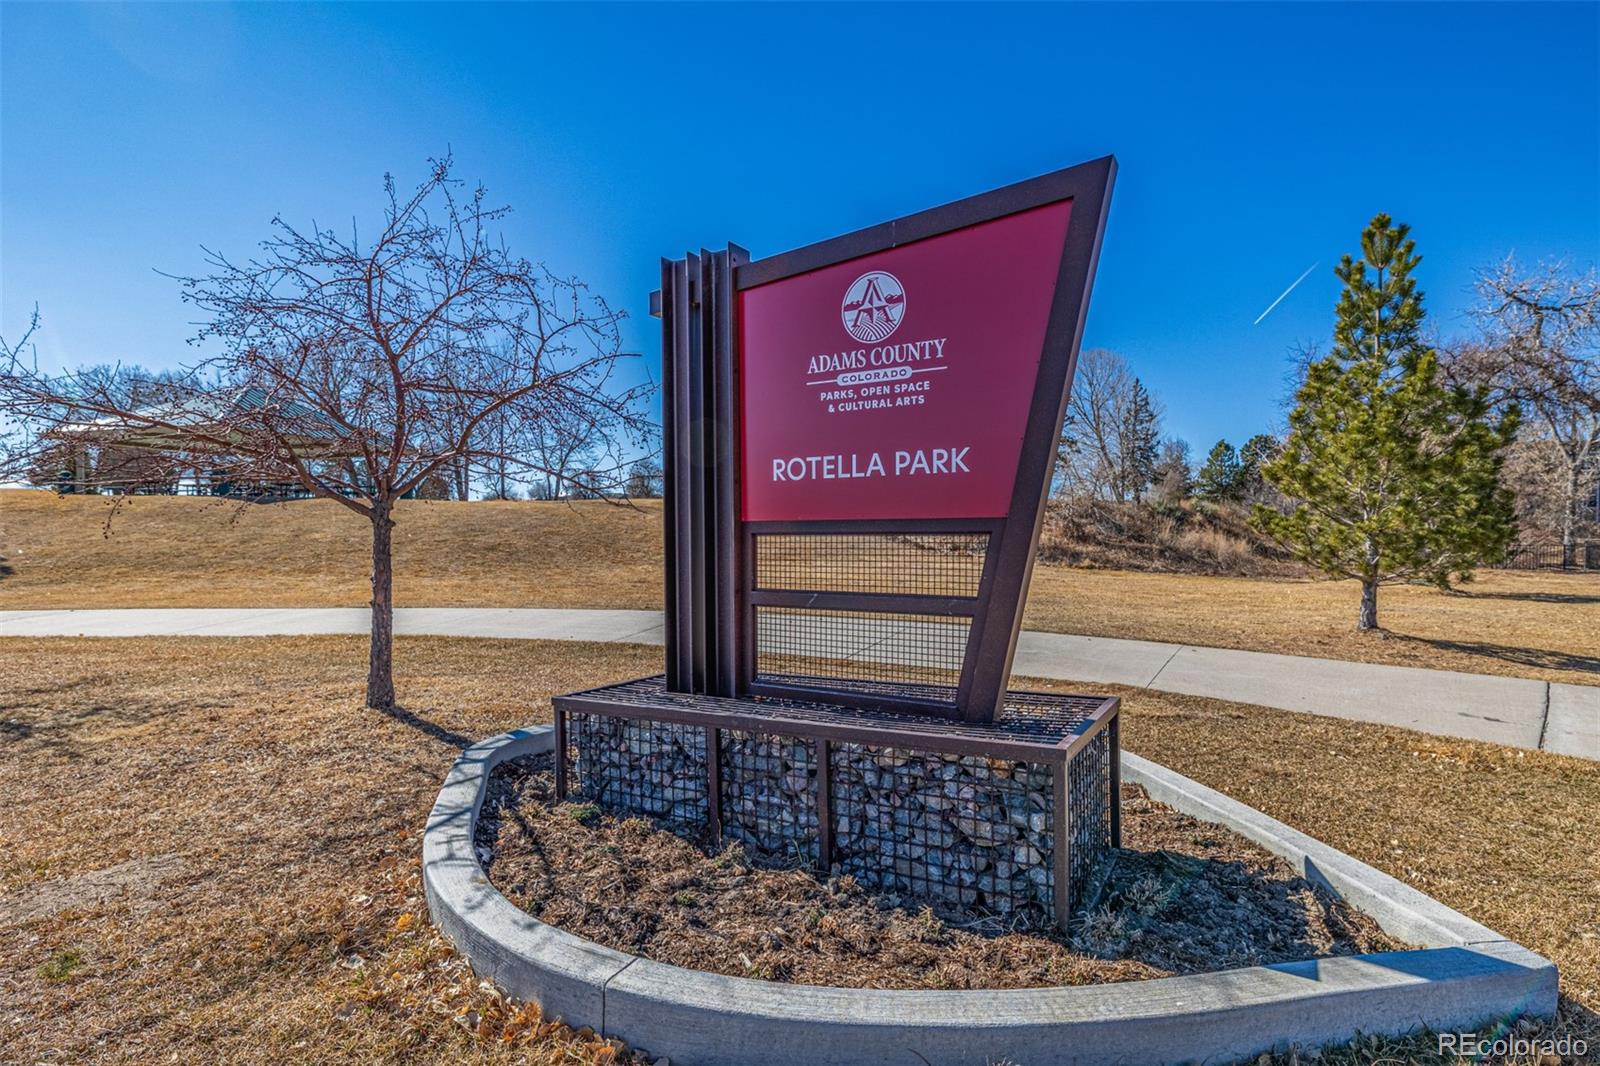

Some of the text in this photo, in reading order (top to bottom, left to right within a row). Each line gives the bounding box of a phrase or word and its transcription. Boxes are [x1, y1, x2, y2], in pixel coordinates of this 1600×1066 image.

[807, 338, 947, 374] ADAMS COUNTY
[841, 368, 908, 384] COLORADO
[820, 380, 931, 401] PARKS, OPEN SPACE
[828, 395, 925, 413] & CULTURAL ARTS
[772, 447, 971, 482] ROTELLA PARK
